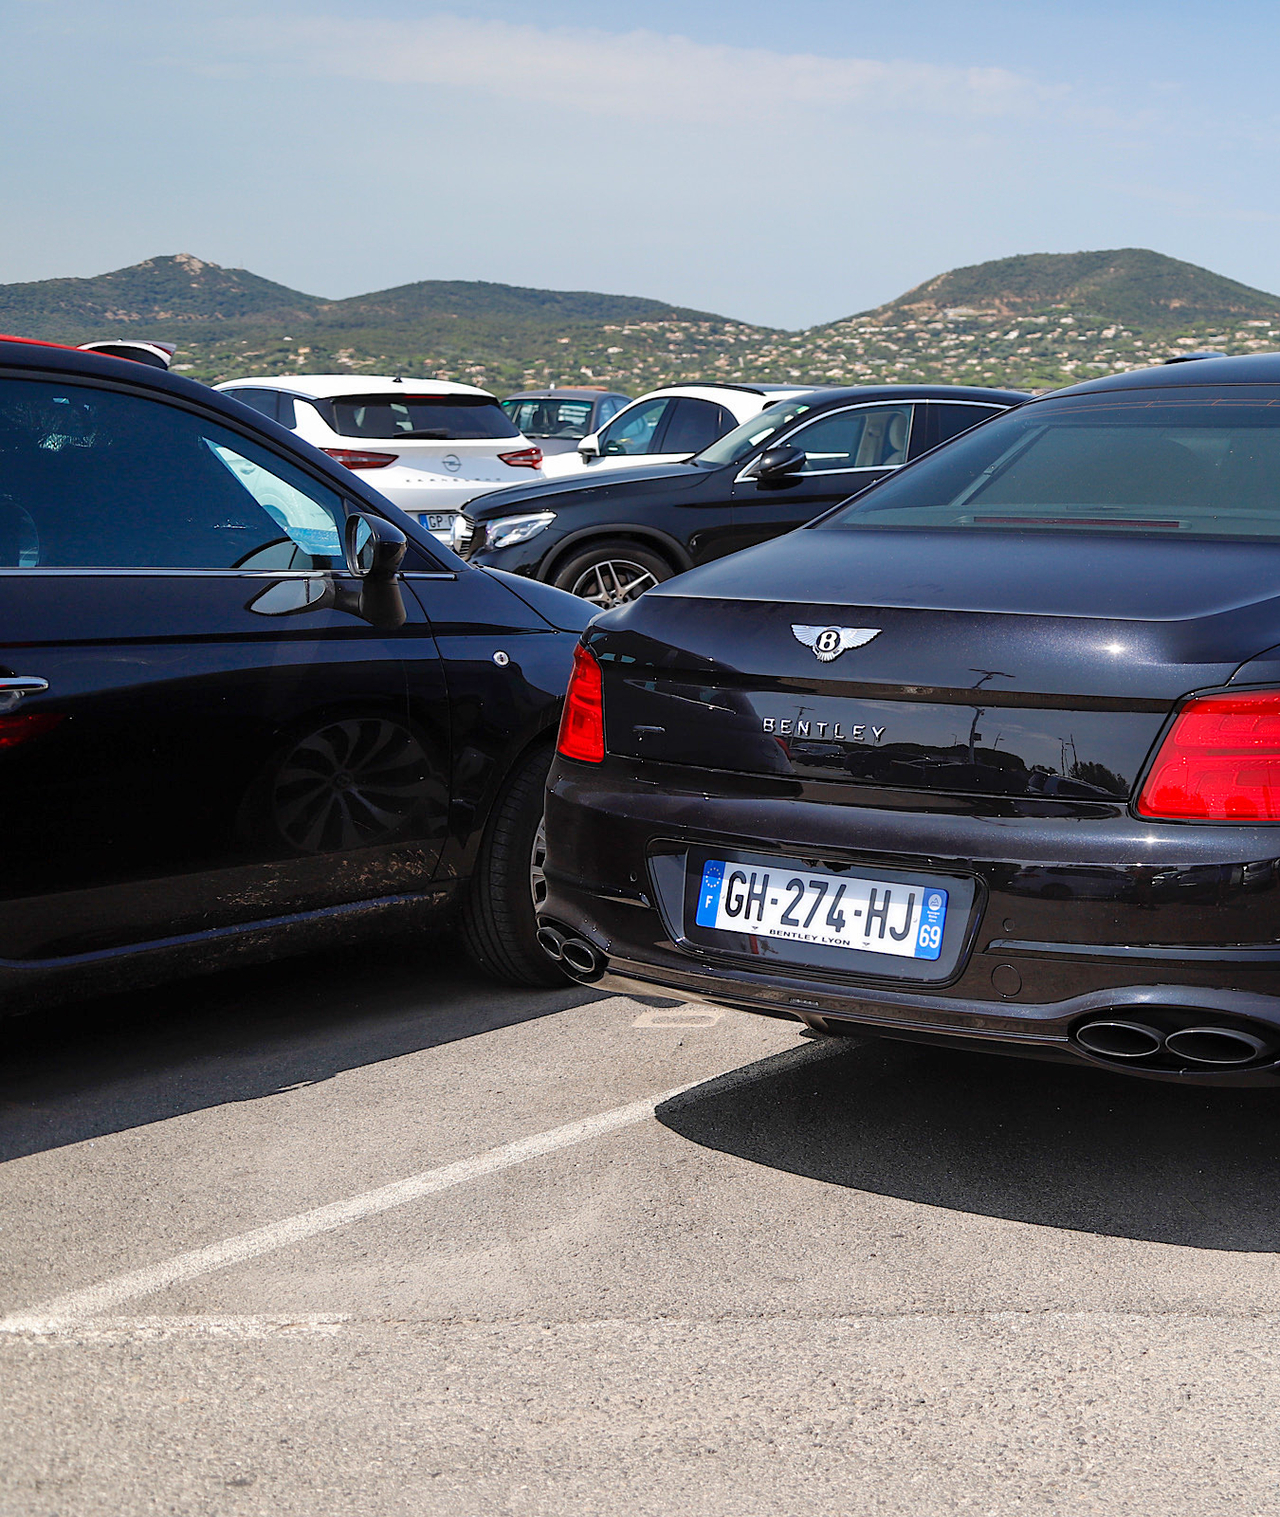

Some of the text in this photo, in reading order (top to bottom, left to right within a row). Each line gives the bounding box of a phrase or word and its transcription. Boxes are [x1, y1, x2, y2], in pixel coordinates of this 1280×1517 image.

[429, 515, 443, 528] GP
[817, 630, 838, 652] B
[763, 718, 886, 742] BENTLEY
[704, 895, 714, 908] F
[725, 870, 915, 941] GH-274-HJ
[769, 928, 851, 946] BENTLEY LYON
[919, 924, 941, 949] 69
